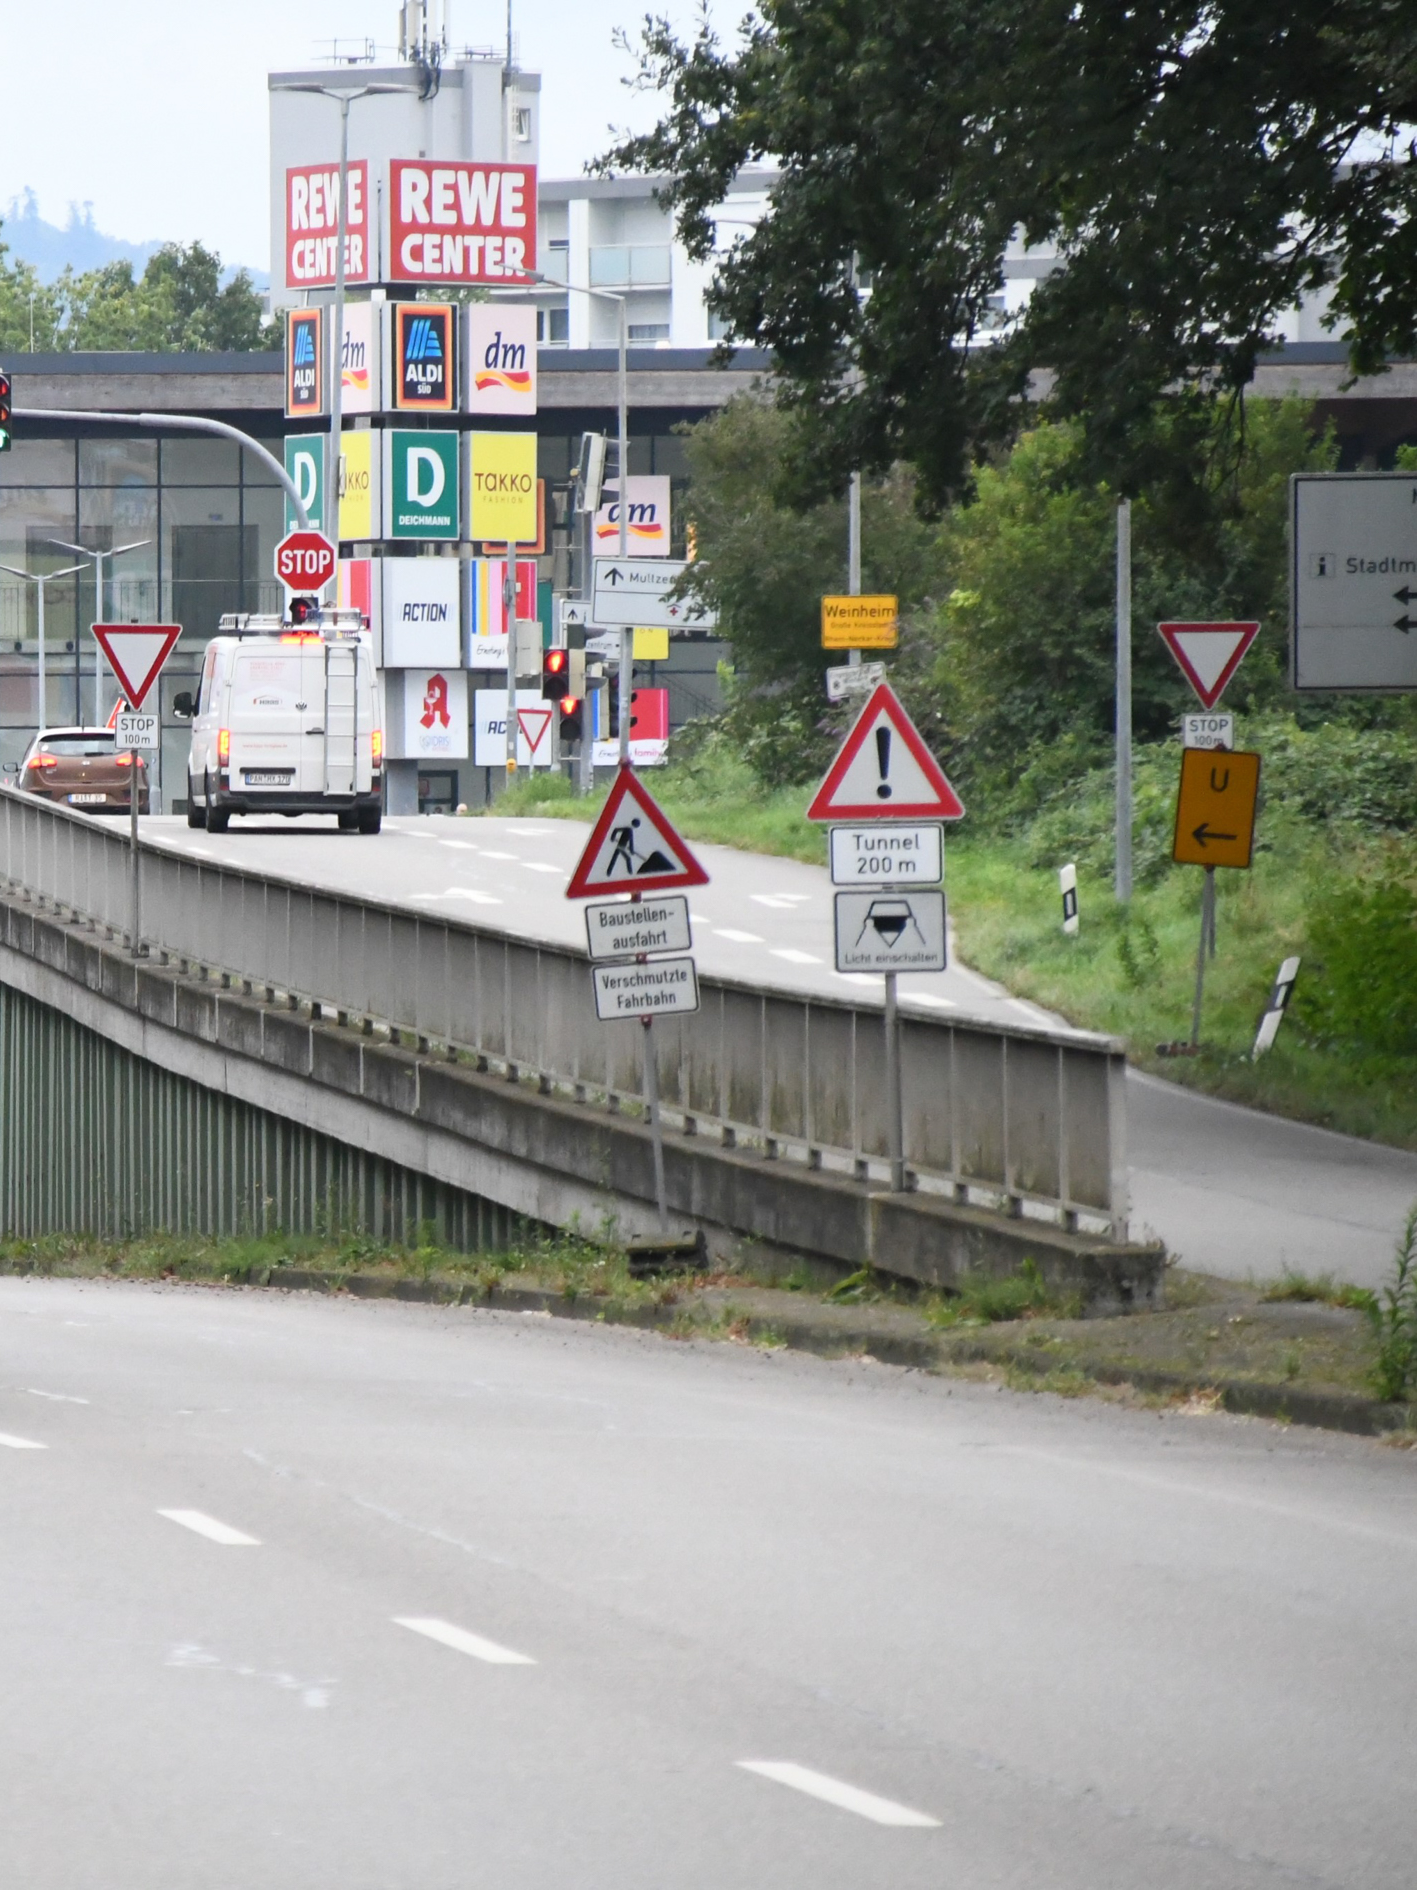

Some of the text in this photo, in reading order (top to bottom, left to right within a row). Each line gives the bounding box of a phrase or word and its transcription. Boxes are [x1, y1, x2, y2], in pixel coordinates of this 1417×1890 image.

[291, 169, 363, 231] REWE
[400, 167, 527, 228] REWE
[291, 234, 364, 279] CENTER
[400, 232, 527, 277] CENTER
[484, 331, 526, 370] dm
[293, 368, 316, 388] ALDI
[405, 363, 443, 383] ALDI
[417, 383, 432, 395] SÜD
[406, 446, 446, 507] D
[482, 495, 524, 504] FASHION
[398, 515, 451, 526] DEICHMANN
[280, 549, 332, 574] STOP
[402, 602, 448, 622] ACTION
[824, 604, 895, 618] Weinheim
[120, 718, 155, 731] STOP
[1189, 719, 1229, 732] STOP
[1210, 766, 1230, 794] U
[853, 833, 920, 851] Tunnel
[857, 856, 916, 874] 200 m
[598, 906, 676, 929] Baustellen-
[612, 930, 668, 950] ausfahrt
[844, 951, 938, 965] Licht einschalten
[601, 968, 688, 991] Verschmutzte
[616, 990, 677, 1010] Fahrbahn
